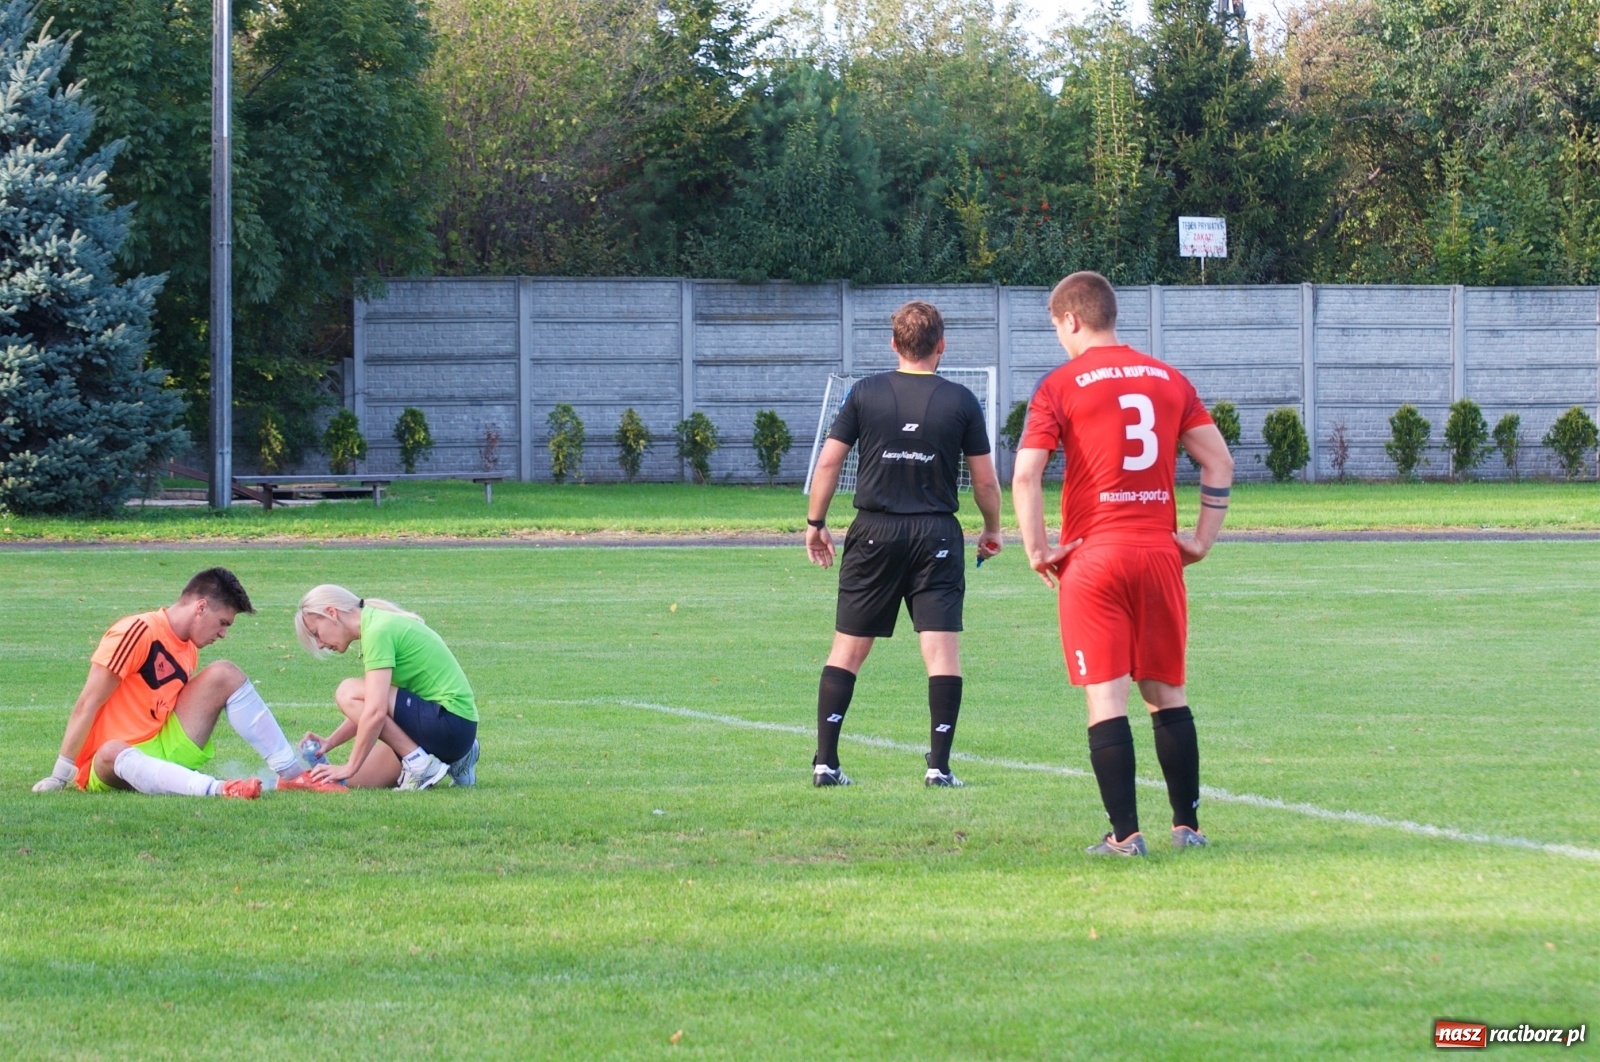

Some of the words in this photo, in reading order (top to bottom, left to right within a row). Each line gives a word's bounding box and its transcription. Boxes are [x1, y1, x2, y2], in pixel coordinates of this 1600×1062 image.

[1075, 366, 1123, 388] GRANICA
[1118, 393, 1159, 471] 3
[1075, 649, 1087, 676] 3
